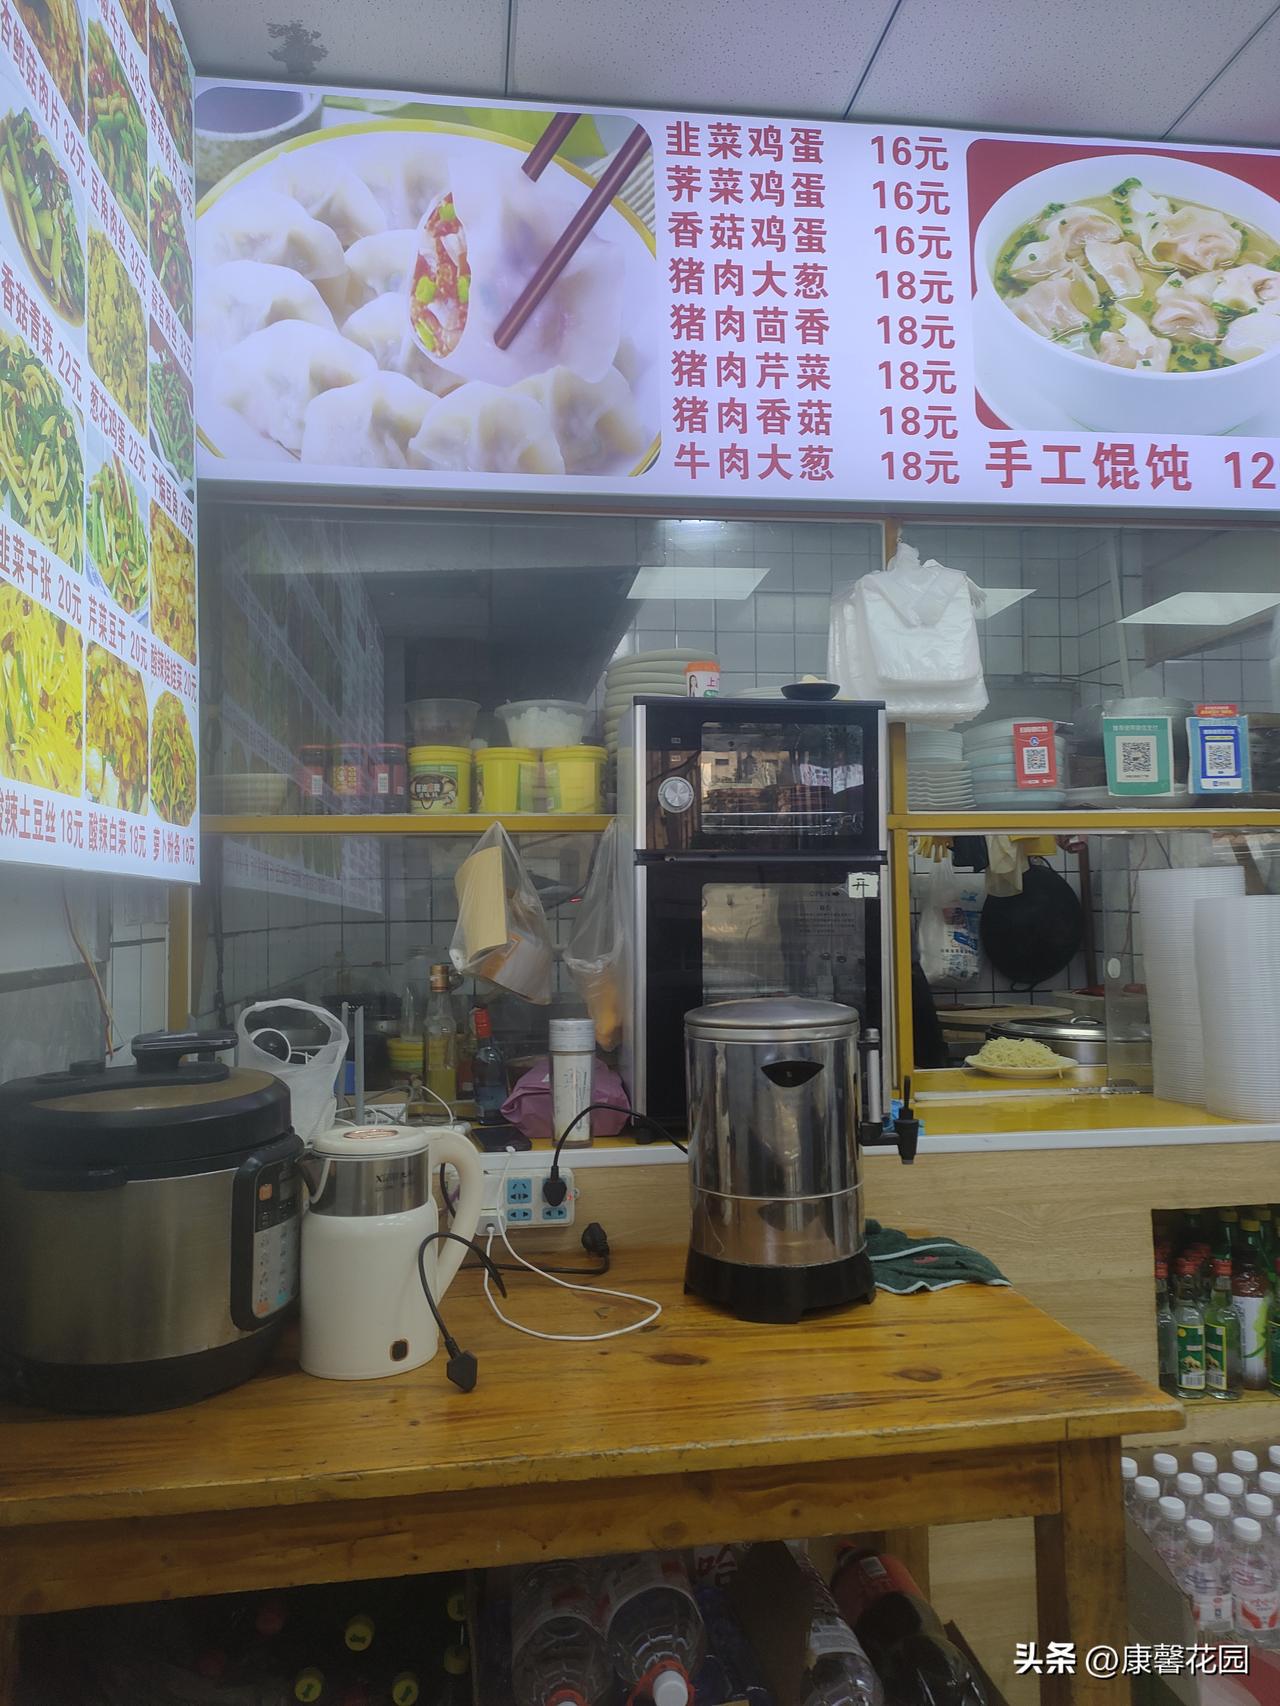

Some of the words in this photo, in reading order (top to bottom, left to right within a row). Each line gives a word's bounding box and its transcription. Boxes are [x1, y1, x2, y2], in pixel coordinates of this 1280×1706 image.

[1, 0, 60, 140] 杏鲍菇肉片
[64, 118, 85, 188] 32元
[130, 52, 147, 115] 68元
[666, 121, 825, 164] 韭菜鸡蛋
[870, 135, 949, 170] 16元
[667, 165, 826, 209] 荠菜鸡蛋
[872, 180, 951, 216] 16元
[91, 166, 126, 260] 豆角肉丝
[130, 243, 146, 295] 32元
[668, 210, 827, 255] 香菇鸡蛋
[874, 225, 952, 260] 16元
[669, 256, 829, 299] 猪肉大葱
[875, 270, 954, 305] 18元
[2, 261, 53, 366] 香菇青菜
[58, 341, 82, 402] 22元
[670, 304, 830, 345] 猪肉茴香
[876, 315, 955, 350] 18元
[671, 349, 832, 391] 猪肉芹菜
[878, 360, 957, 396] 18元
[90, 380, 125, 457] 葱花鸡蛋
[128, 434, 146, 482] 22元
[672, 396, 833, 437] 猪肉香菇
[879, 405, 959, 440] 18元
[675, 444, 834, 482] 牛肉大葱
[881, 450, 960, 485] 18元
[986, 440, 1192, 491] 手工馄饨
[1224, 450, 1276, 489] 12
[0, 524, 51, 603] 韭菜千张
[58, 574, 82, 625] 20元
[88, 594, 126, 656] 芹菜豆干
[130, 630, 147, 671] 20元
[61, 808, 83, 849] 18元
[88, 811, 127, 856] 酸辣白菜
[130, 825, 146, 858] 18元
[182, 836, 195, 866] 18元
[852, 878, 870, 898] 开
